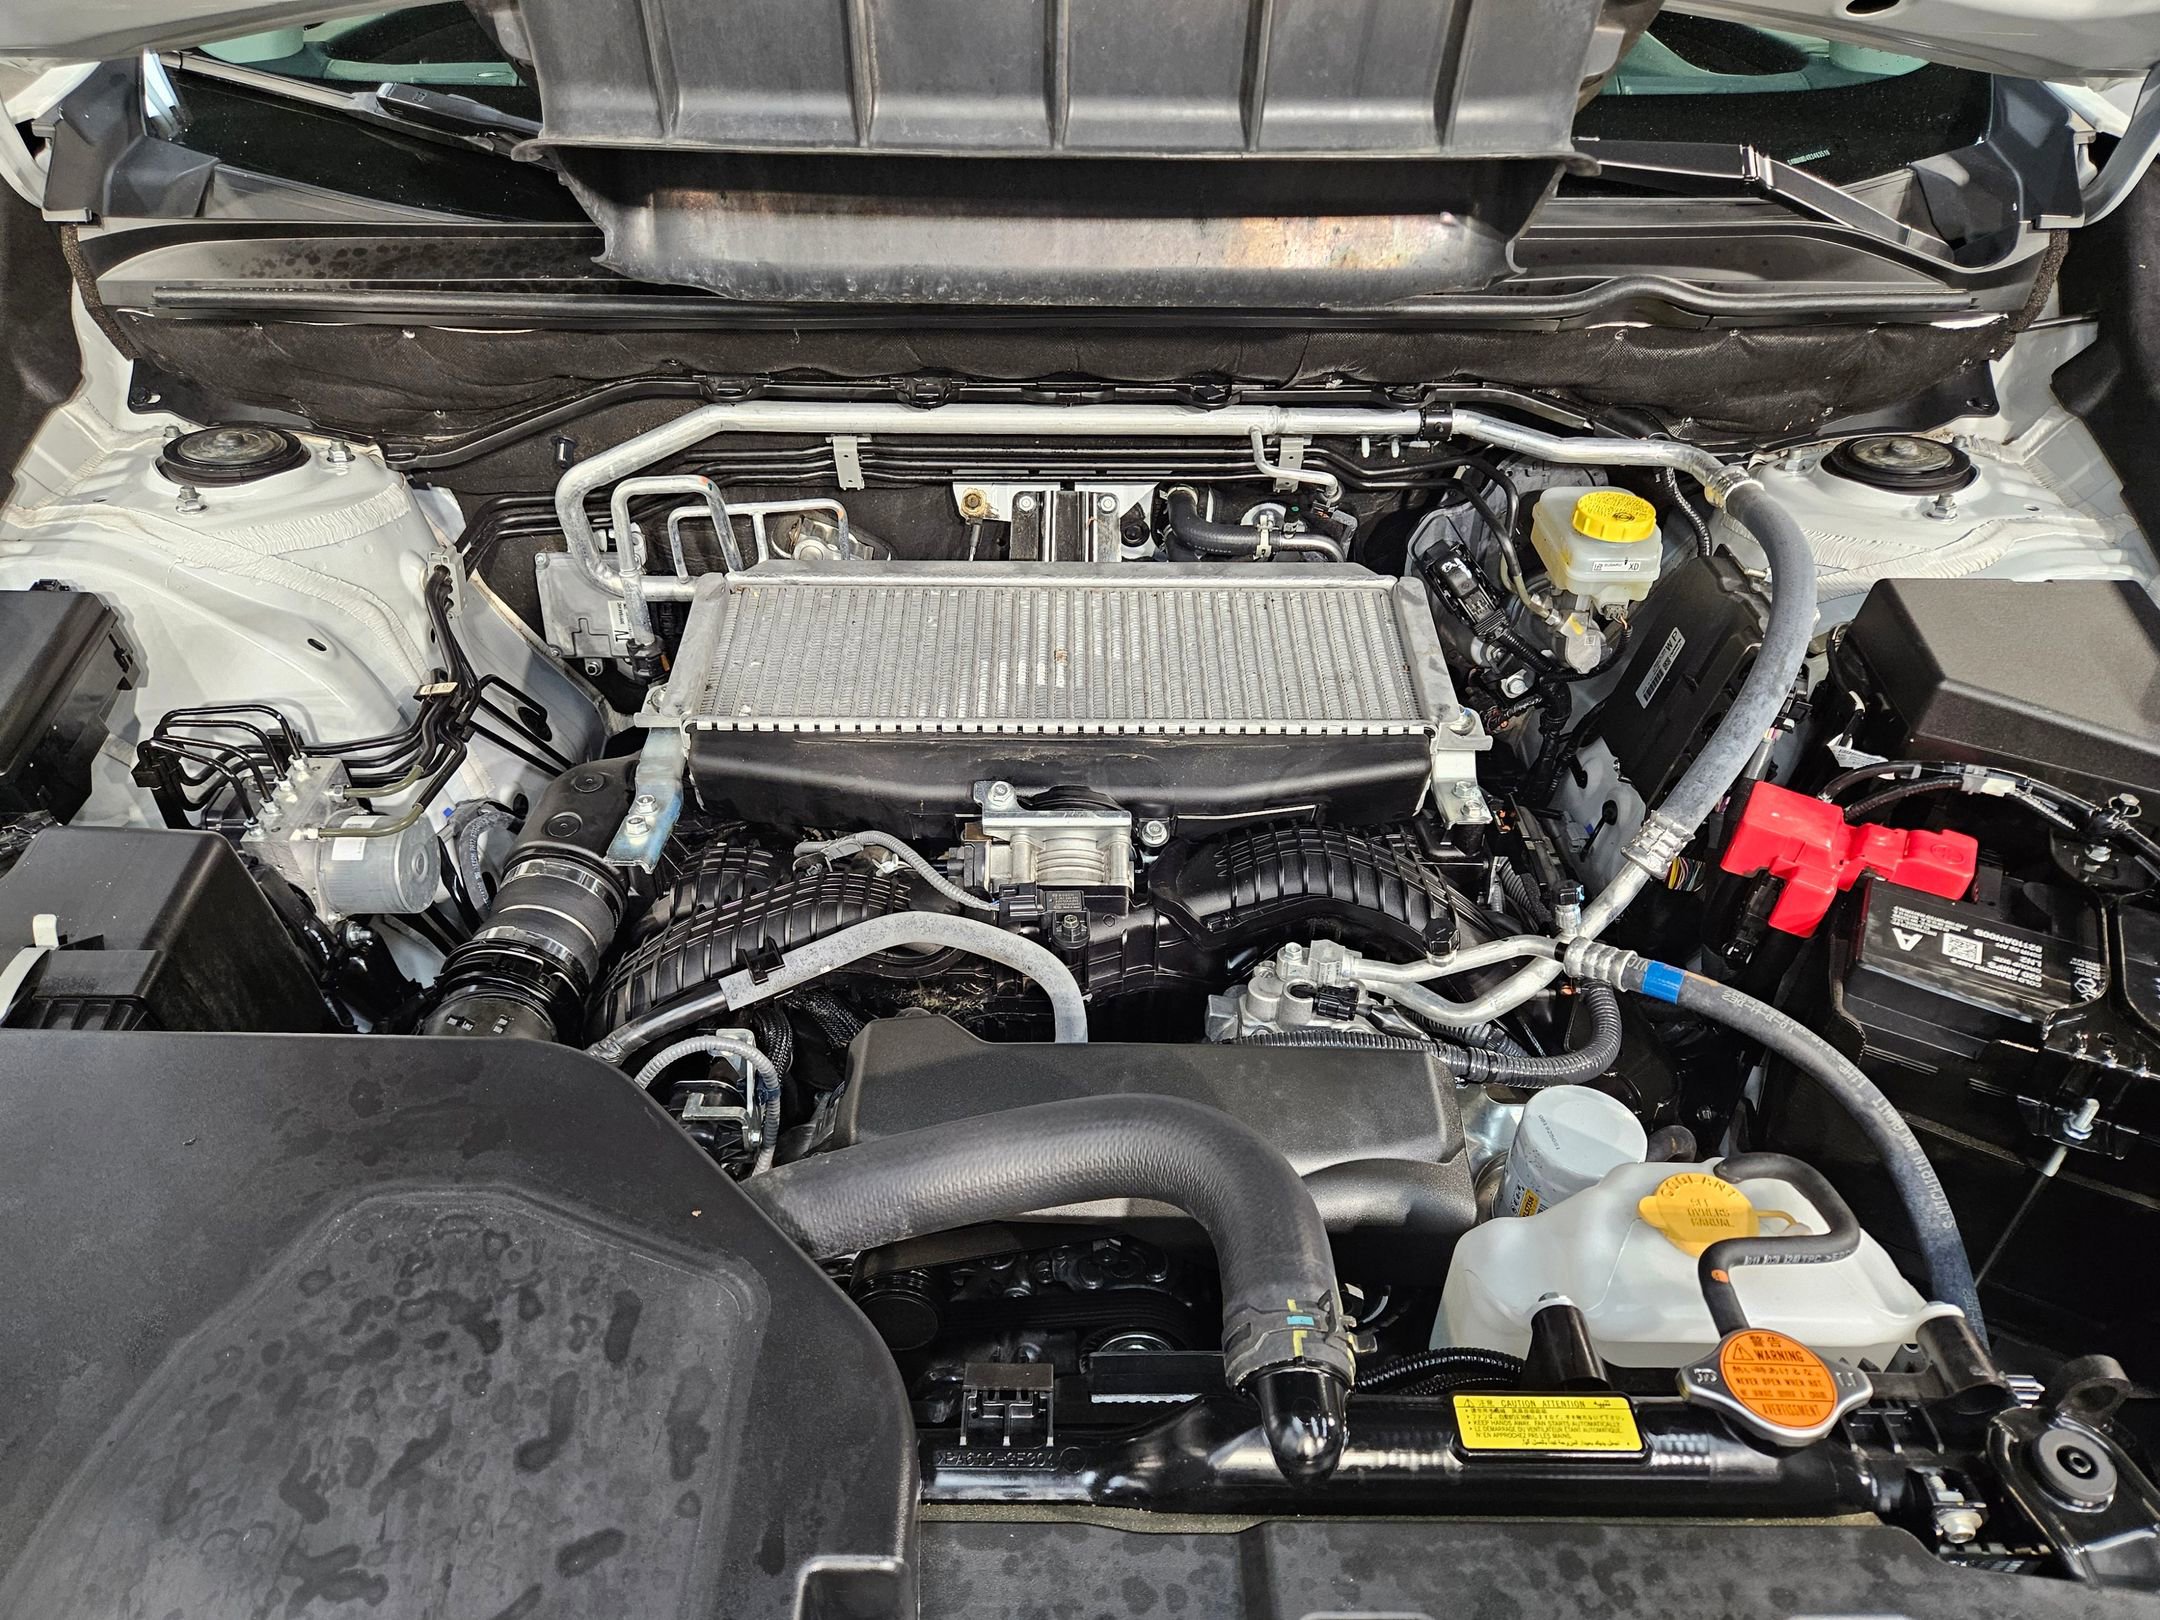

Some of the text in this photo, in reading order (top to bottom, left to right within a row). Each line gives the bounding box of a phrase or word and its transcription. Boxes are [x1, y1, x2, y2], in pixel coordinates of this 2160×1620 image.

[615, 630, 630, 642] TV
[1949, 957, 2042, 988] COLD CRANKING AMPS
[1986, 961, 2021, 976] AMPS
[2012, 961, 2042, 974] GROUP
[1754, 1349, 1804, 1362] WARNING
[1501, 1400, 1586, 1408] CAUTION ATTENTION
